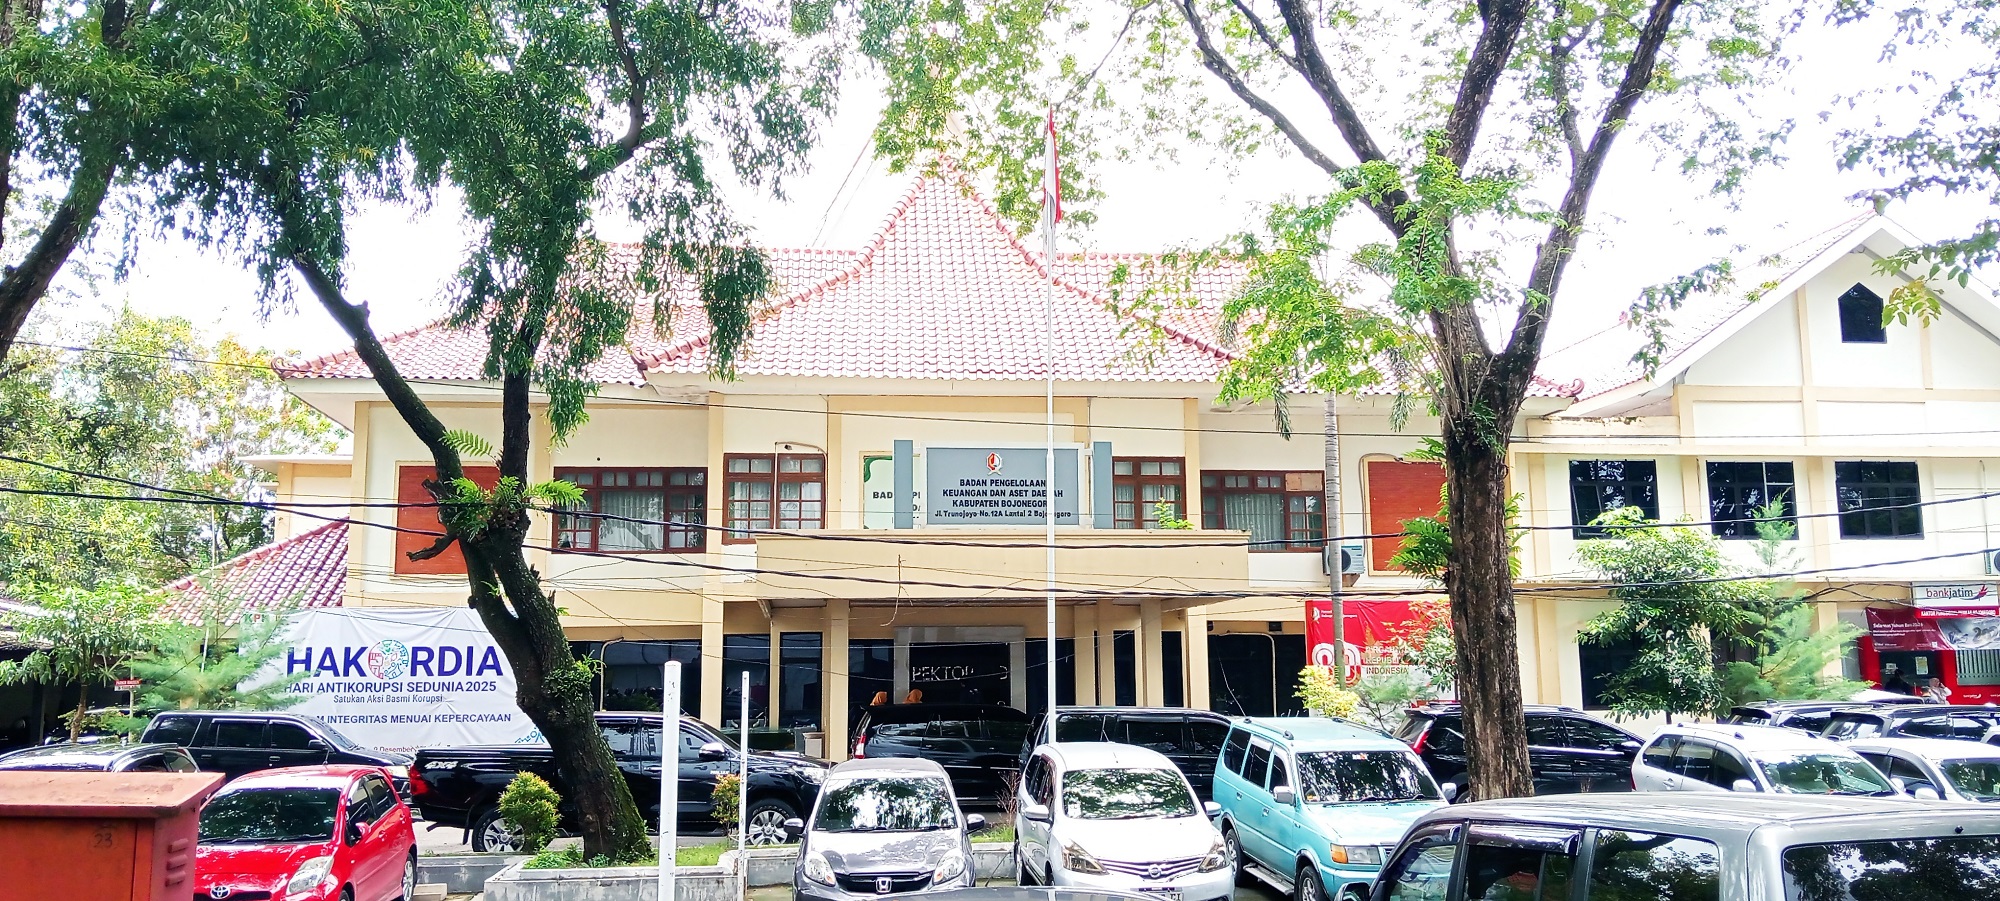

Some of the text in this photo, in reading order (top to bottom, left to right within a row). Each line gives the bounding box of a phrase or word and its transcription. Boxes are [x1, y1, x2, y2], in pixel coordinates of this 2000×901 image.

[960, 479, 1046, 488] BADAN PENGELOLAAN
[942, 489, 1063, 498] KEUANGAN DAN ASET DAEAH
[952, 499, 1049, 508] KABUPATEN BOJONEGOR
[1034, 510, 1072, 519] Bojgoro
[1926, 587, 1973, 600] bankjatim
[317, 682, 403, 693] ANTIKORUPSI
[465, 681, 497, 692] 2025
[333, 694, 365, 703] Satukan
[366, 694, 384, 703] Aksi
[385, 694, 411, 703] Basmi
[327, 715, 388, 724] INTEGRITAS
[390, 714, 432, 723] MENUAI
[434, 713, 512, 723] KEPERCAYAAN
